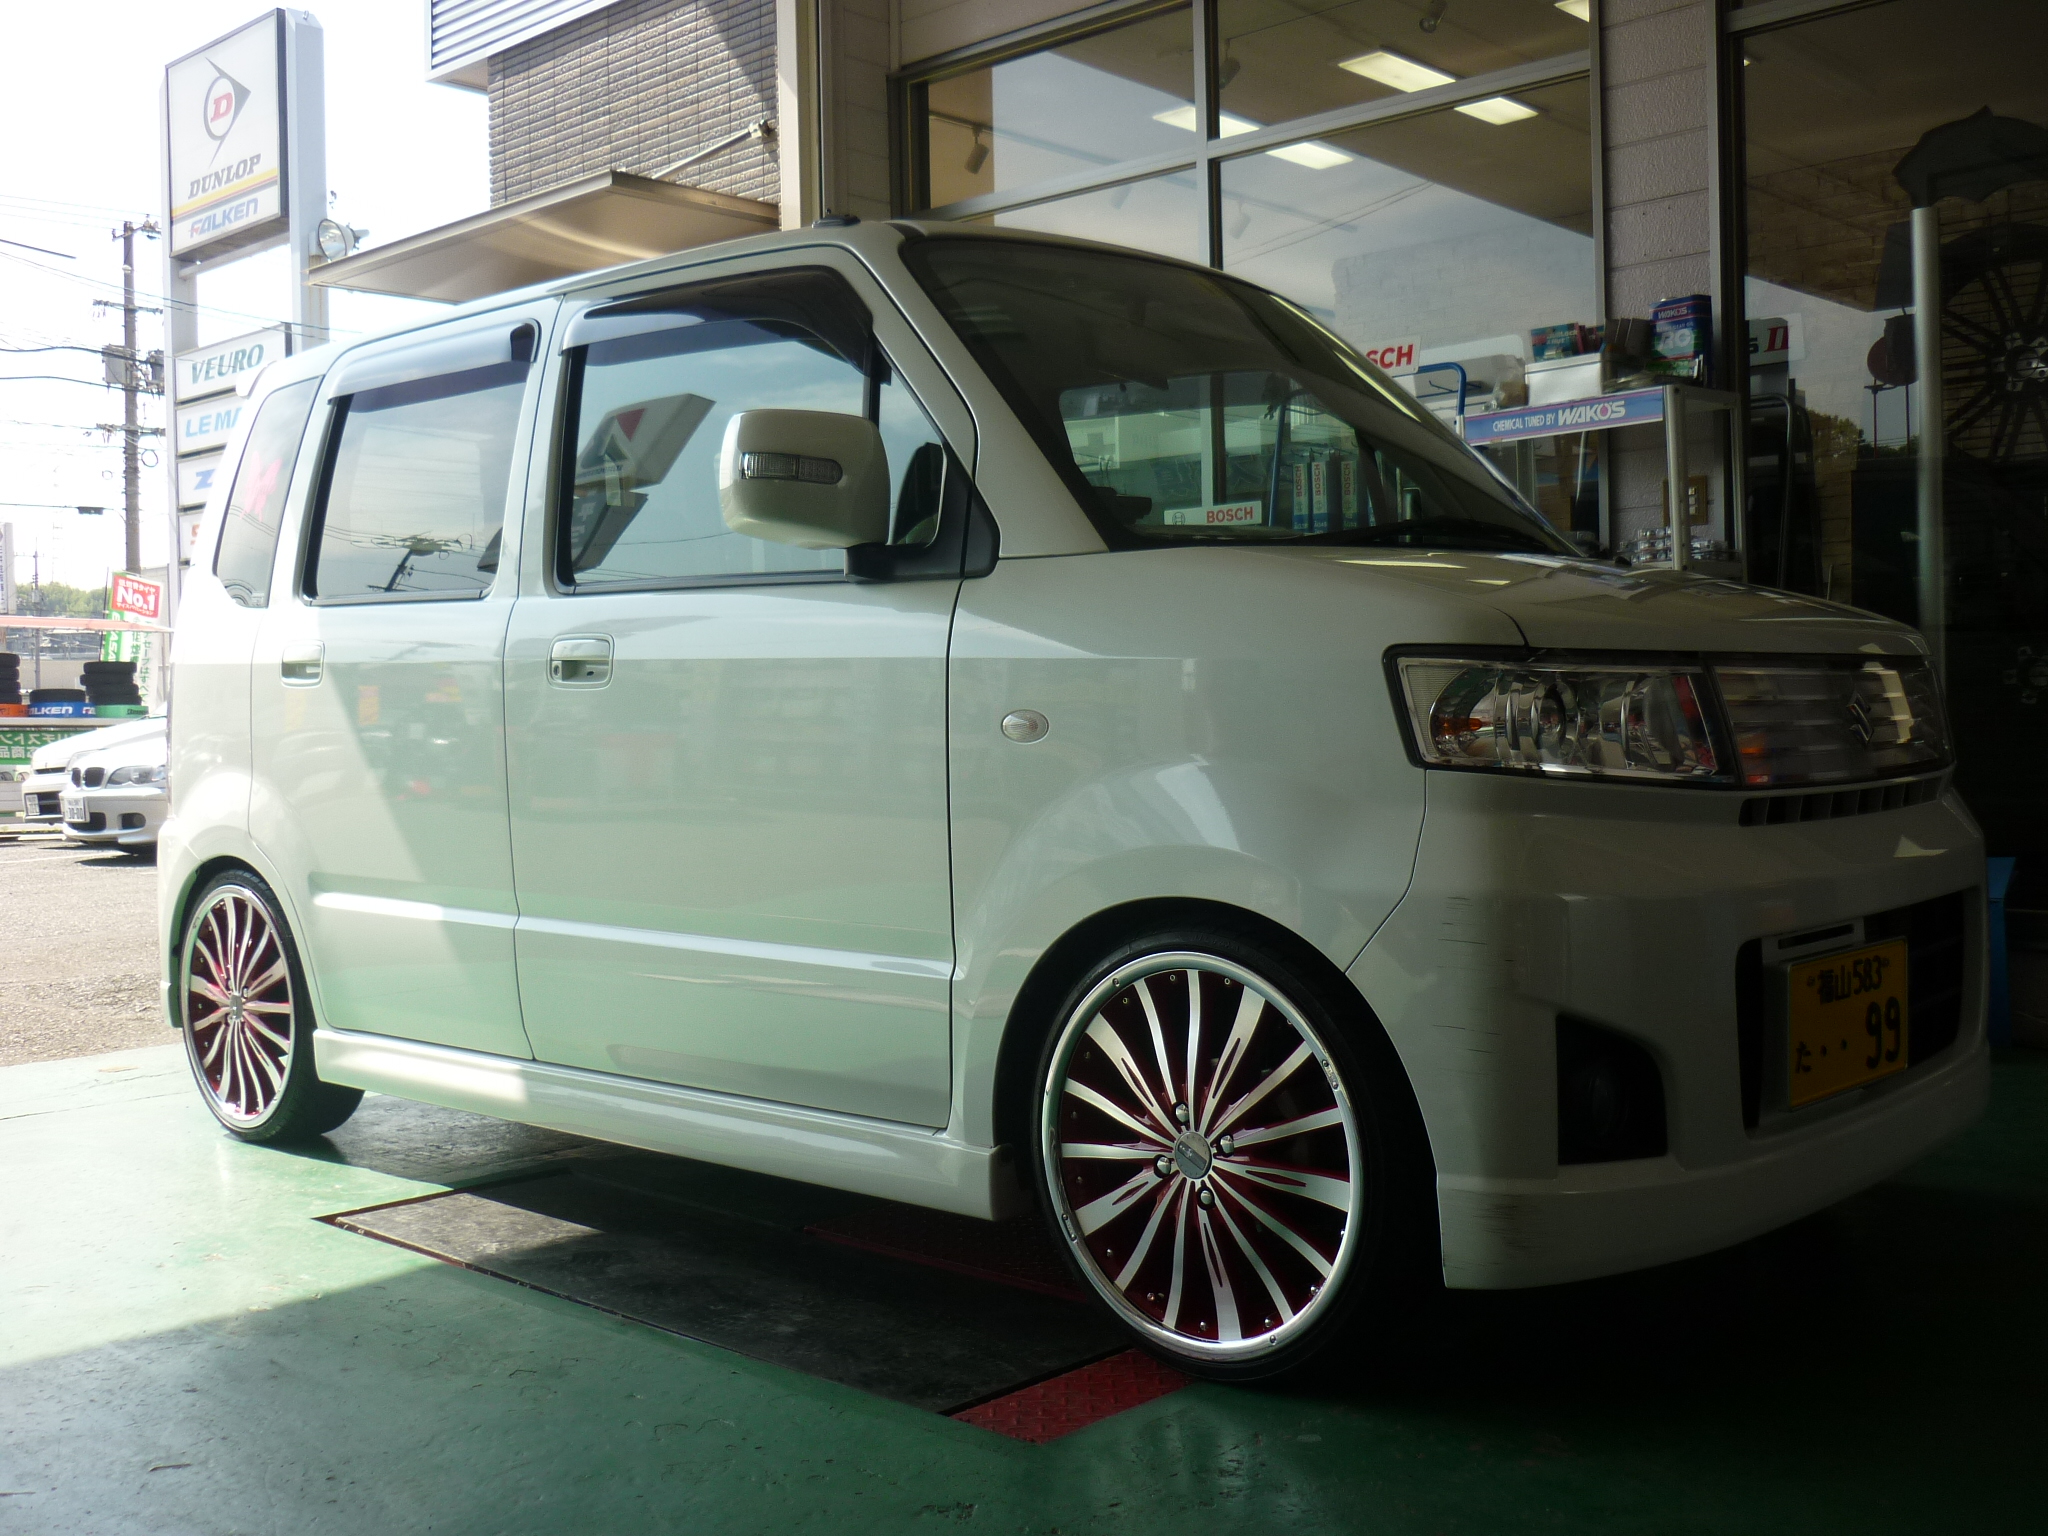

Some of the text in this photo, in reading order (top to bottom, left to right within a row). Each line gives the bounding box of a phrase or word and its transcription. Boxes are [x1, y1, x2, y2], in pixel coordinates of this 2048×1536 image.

[188, 153, 262, 200] DUNLOP
[189, 197, 259, 239] FALKEN
[191, 344, 265, 385] VEURO
[1493, 419, 1523, 432] CHEMICAL
[1525, 415, 1545, 428] TUNED
[1546, 412, 1556, 425] BY
[1343, 463, 1351, 496] BOSCH
[1206, 506, 1254, 524] BOSCH
[117, 586, 155, 611] No.1
